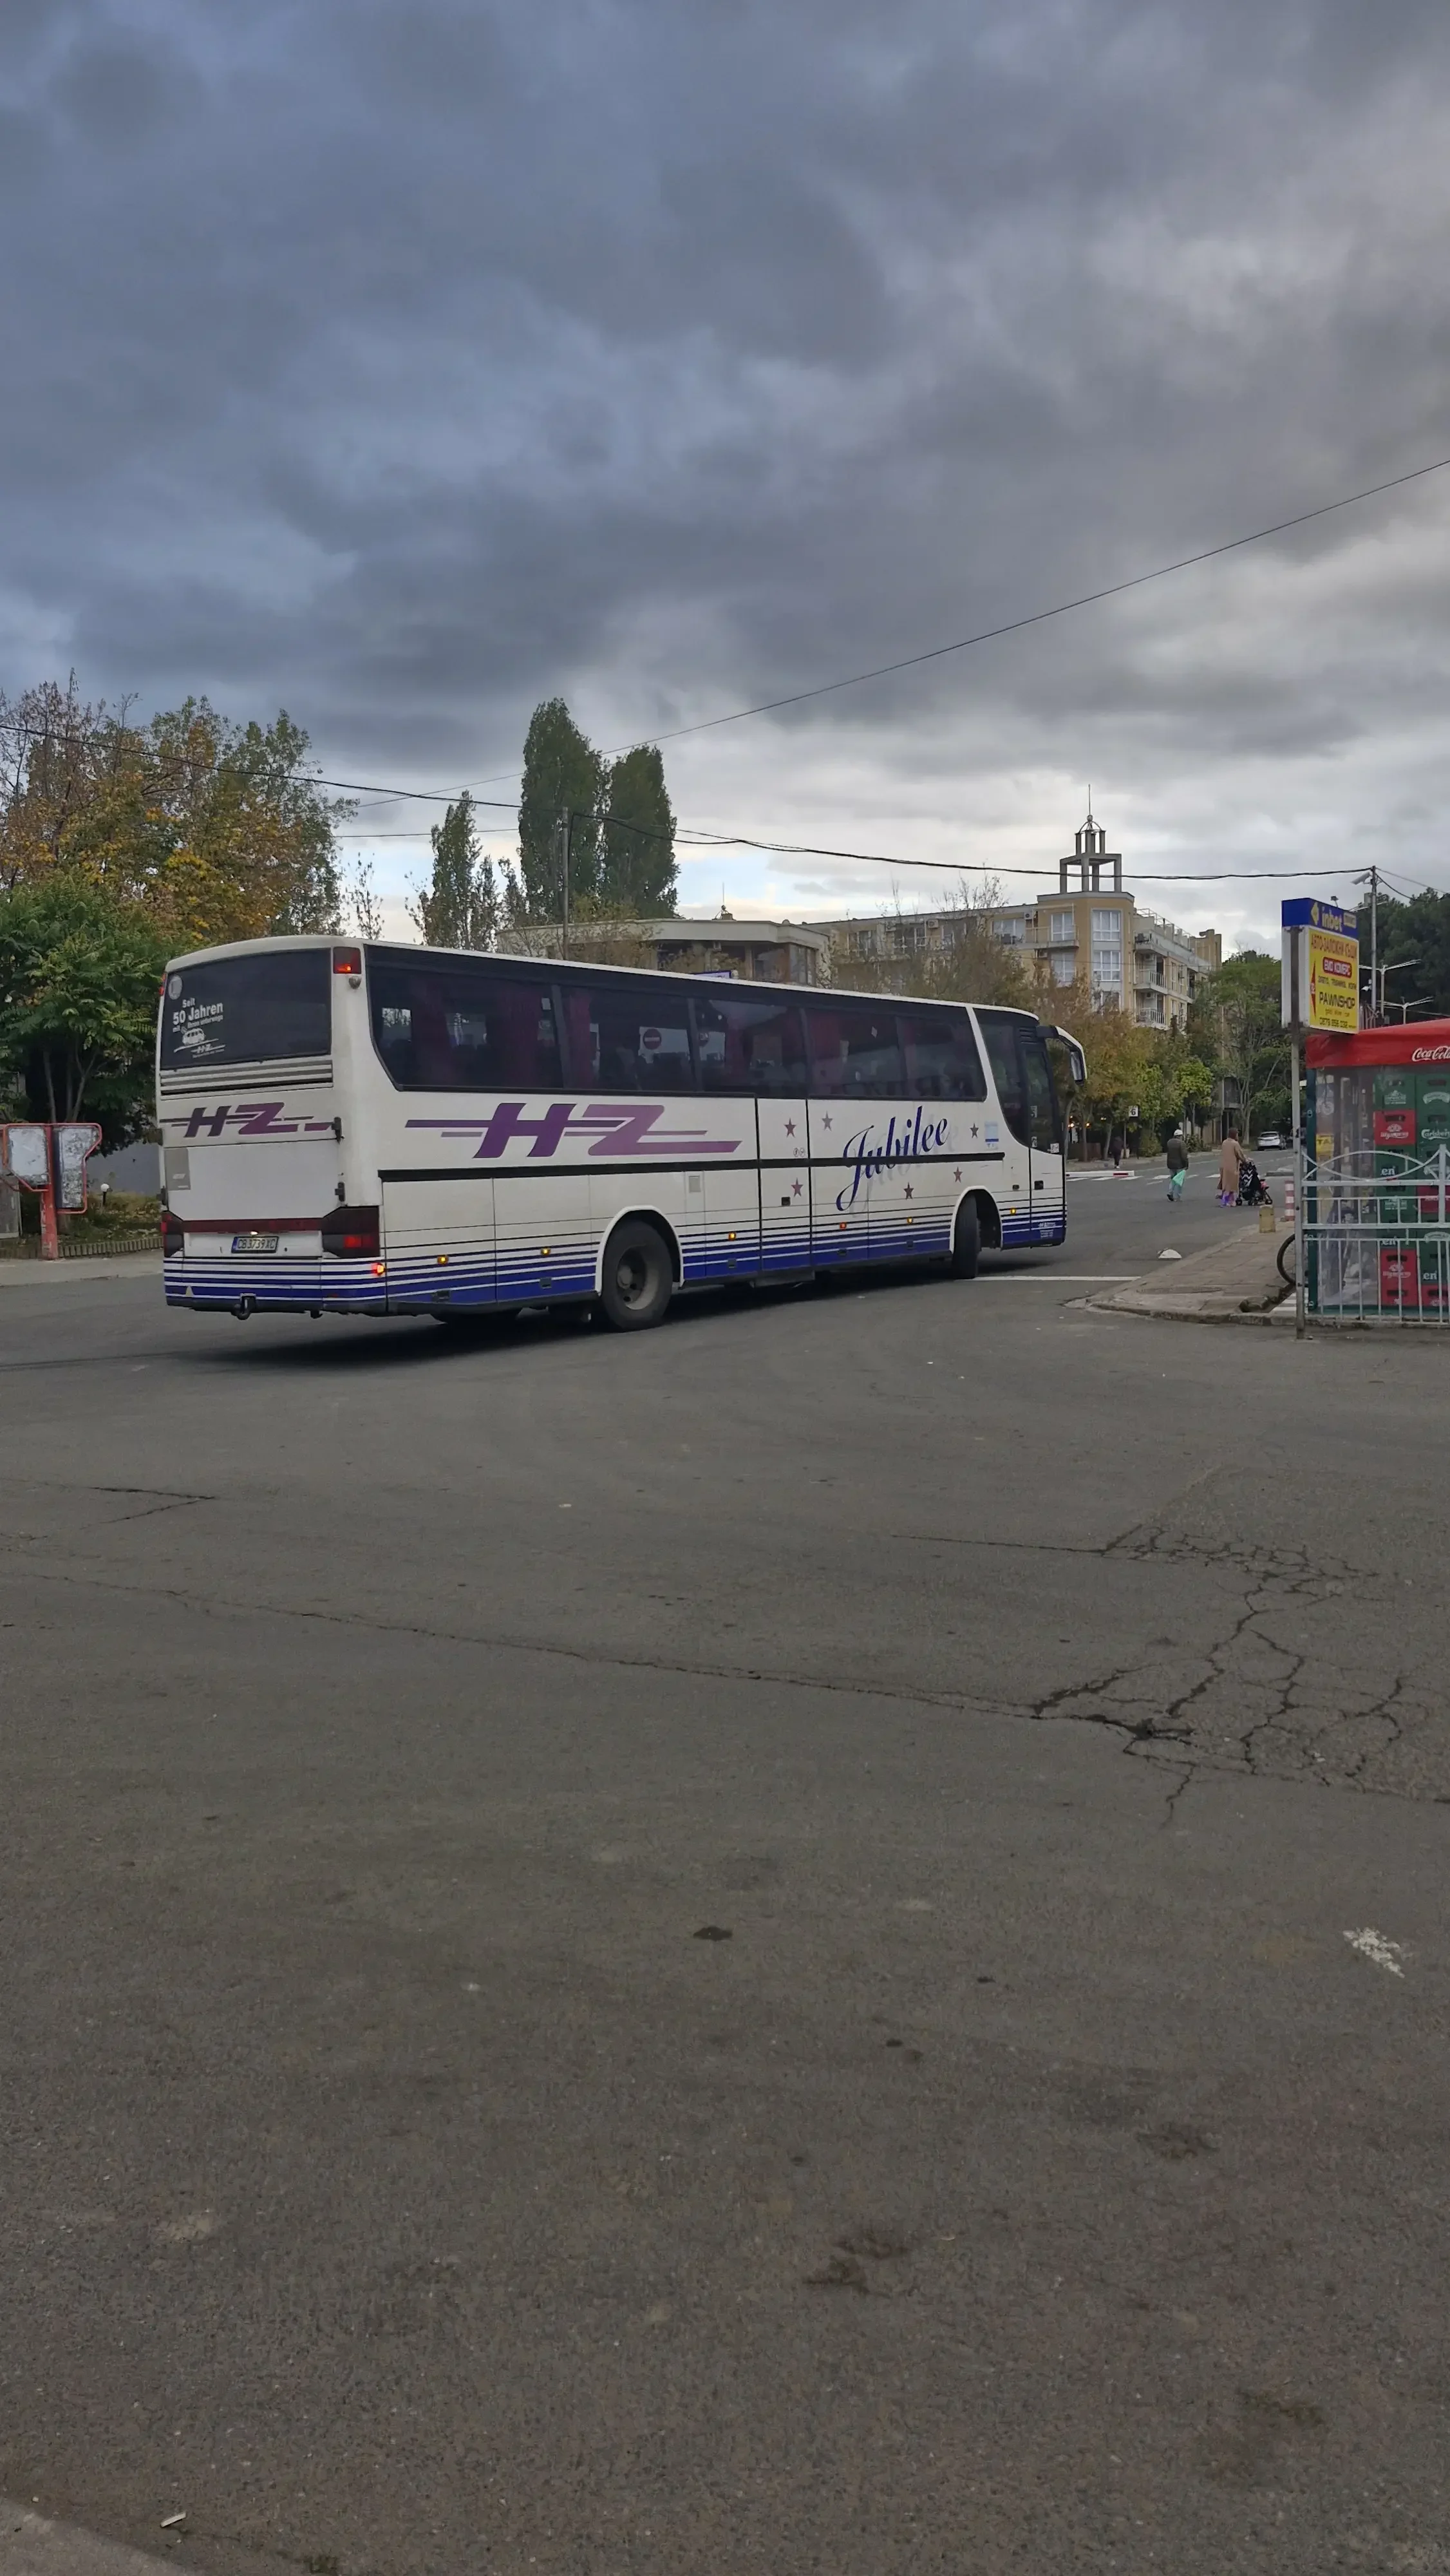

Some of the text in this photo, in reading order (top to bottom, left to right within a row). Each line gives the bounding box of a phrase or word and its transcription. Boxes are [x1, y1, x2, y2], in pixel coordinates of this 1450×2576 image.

[1322, 906, 1342, 933] inbet
[173, 1003, 223, 1025] 50 Jahren
[1319, 992, 1355, 1009] PAWNSHOP
[184, 1102, 333, 1137] HZ
[473, 1103, 742, 1159] HZ
[836, 1106, 948, 1211] Jubilee
